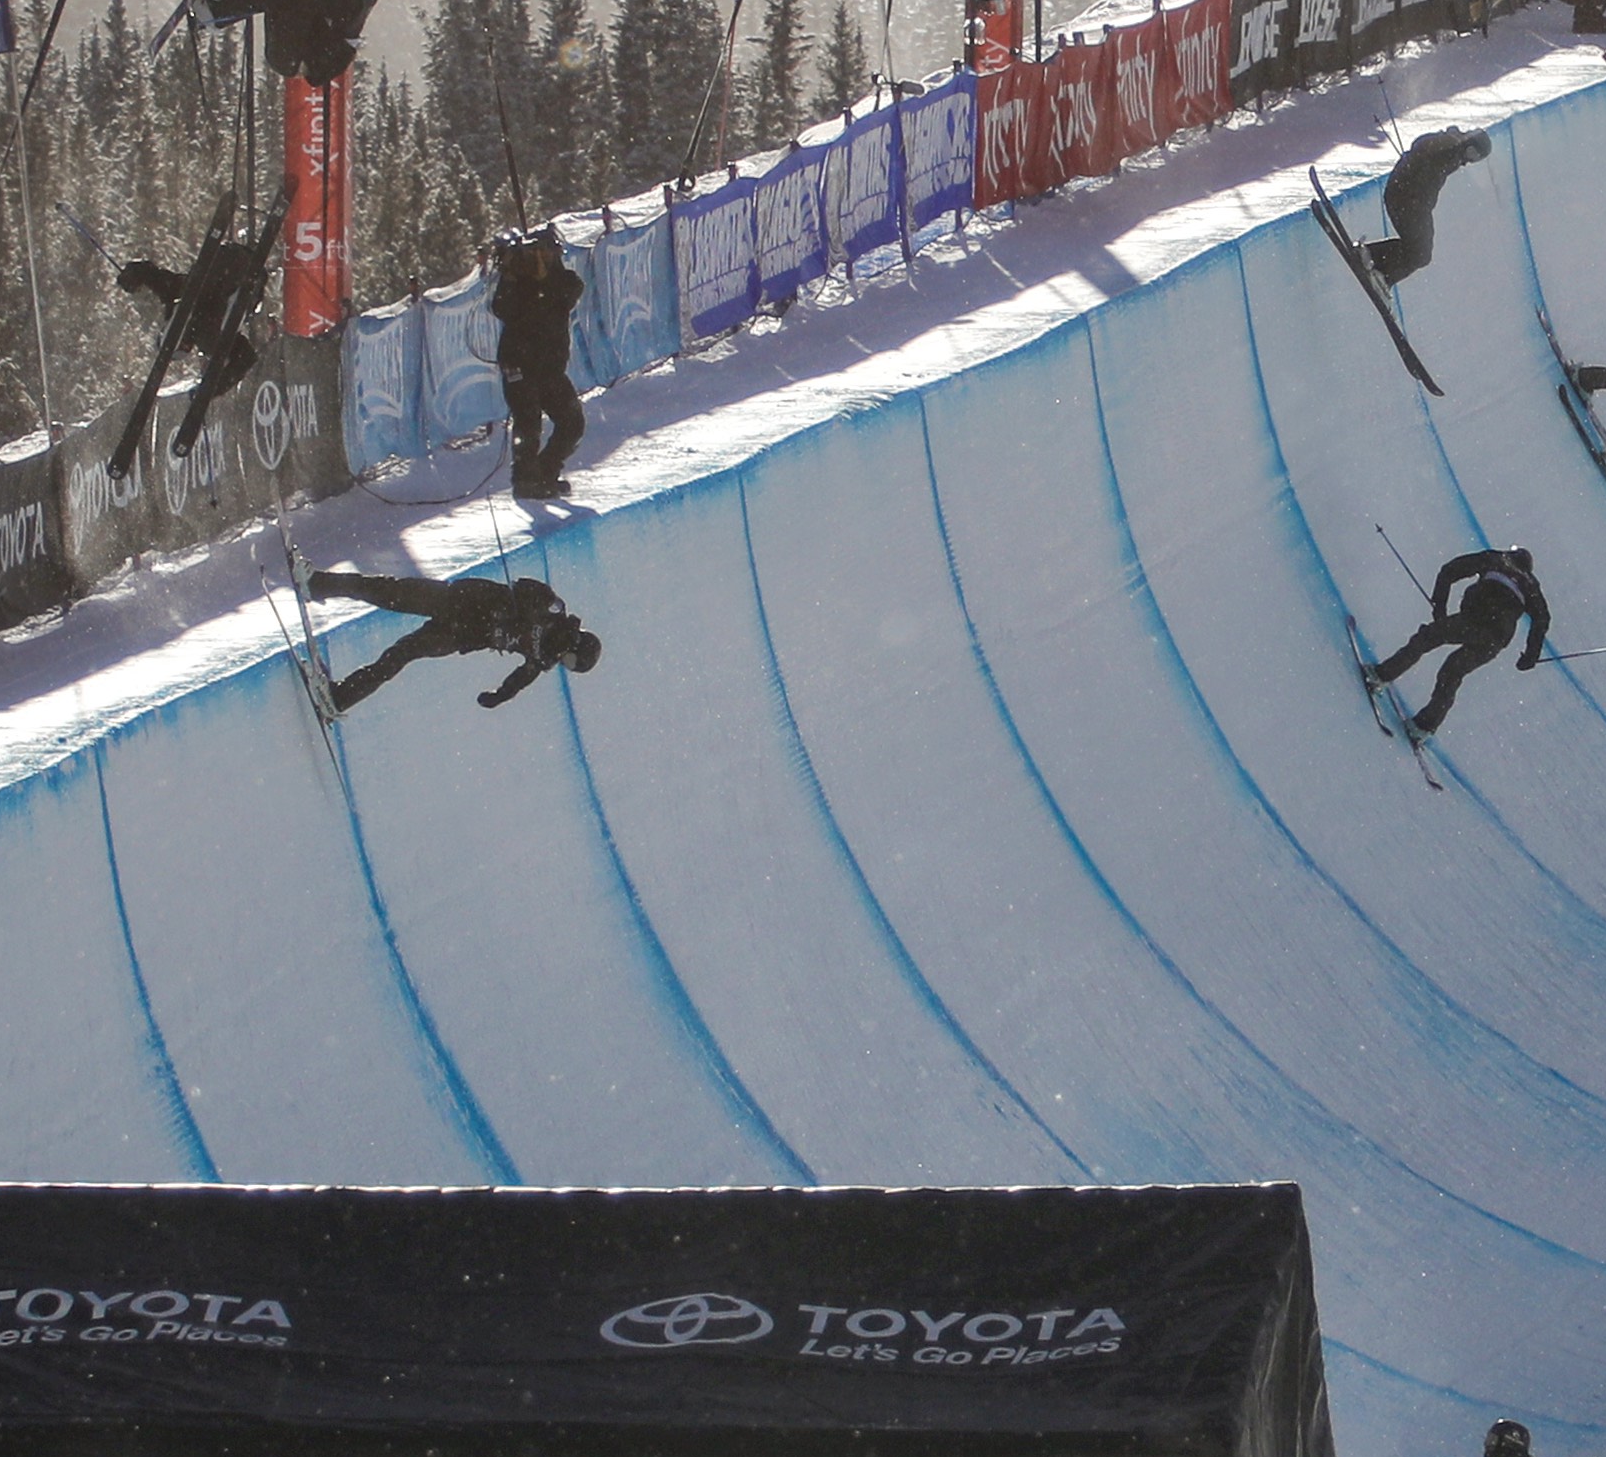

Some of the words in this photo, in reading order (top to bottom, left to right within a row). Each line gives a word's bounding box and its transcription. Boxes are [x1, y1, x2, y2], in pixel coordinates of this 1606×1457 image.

[293, 221, 323, 262] 5
[79, 1325, 140, 1342] Go
[146, 1320, 289, 1347] Places
[797, 1303, 1128, 1342] TOYOTA
[799, 1338, 900, 1362] Let's
[912, 1346, 973, 1365] Go
[980, 1336, 1123, 1365] Places
